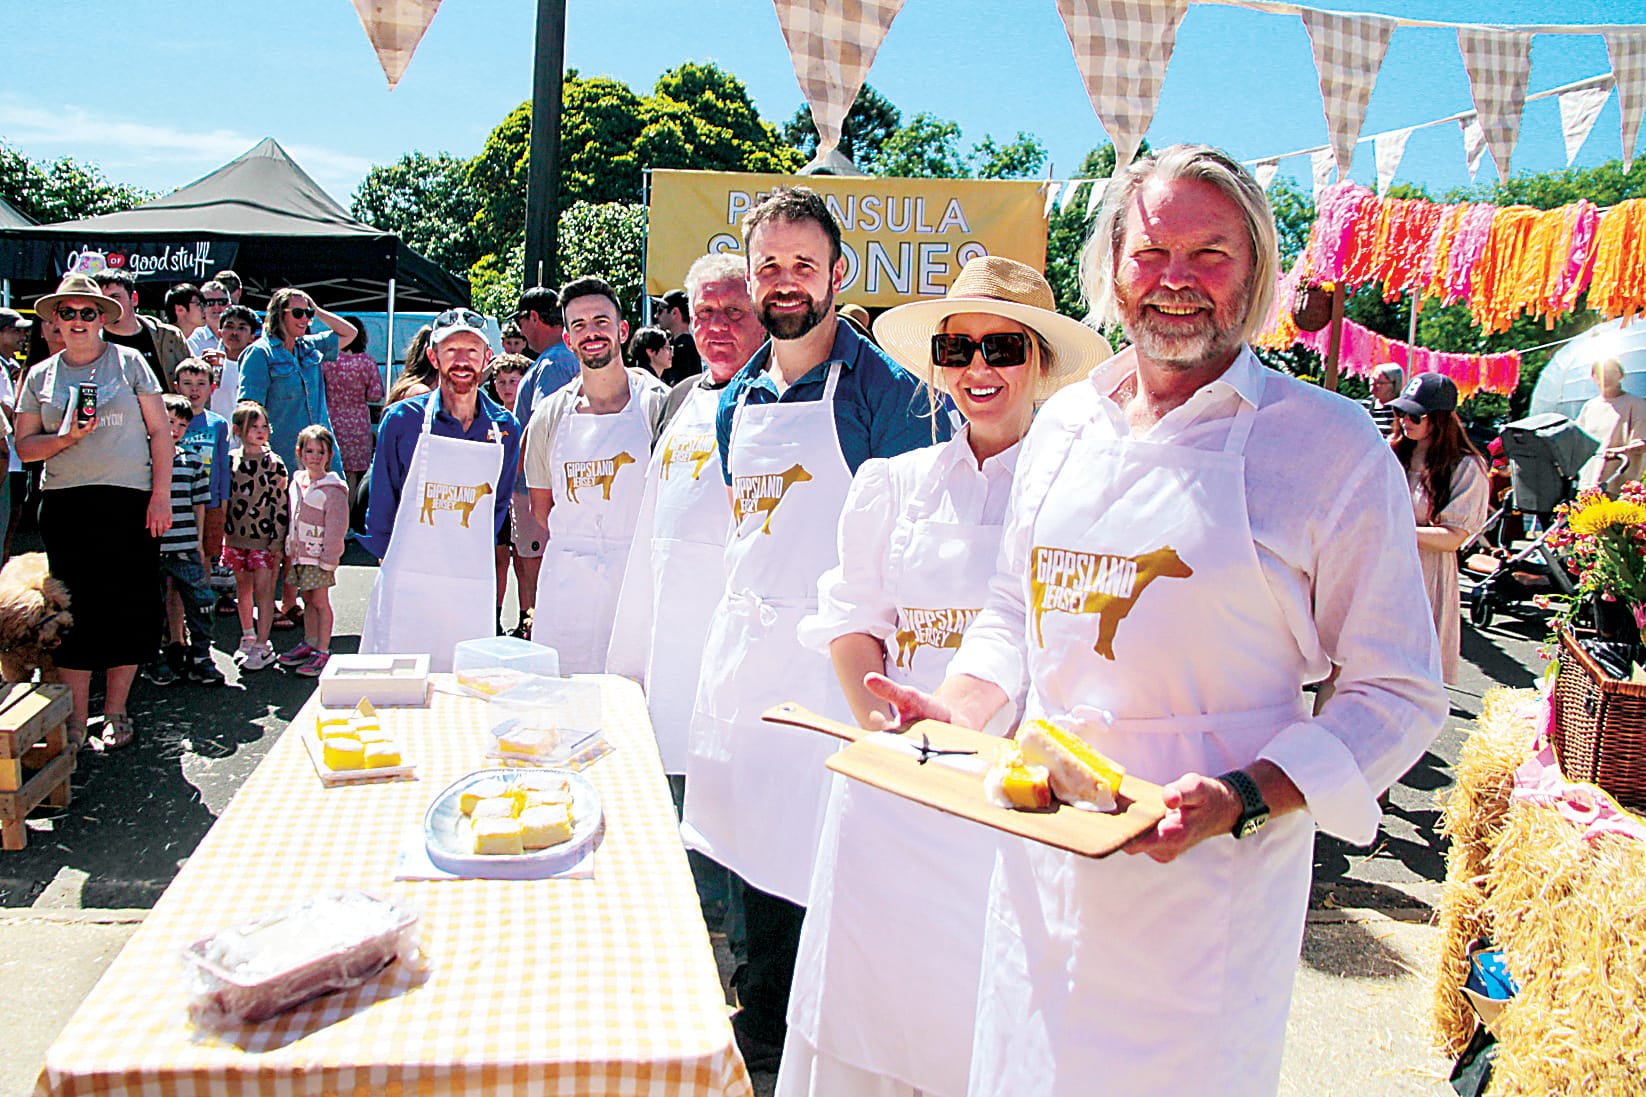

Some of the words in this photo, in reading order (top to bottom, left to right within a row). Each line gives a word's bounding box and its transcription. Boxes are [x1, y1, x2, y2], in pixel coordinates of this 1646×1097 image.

[727, 190, 971, 234] PNSULA
[567, 460, 614, 478] GIPPSLAND
[426, 483, 476, 503] GIPPSLAND
[736, 475, 784, 499] IPPSLAND
[1036, 548, 1138, 599] GIPPSLAND
[1041, 584, 1089, 613] JERSEY
[914, 627, 951, 648] JERSEY
